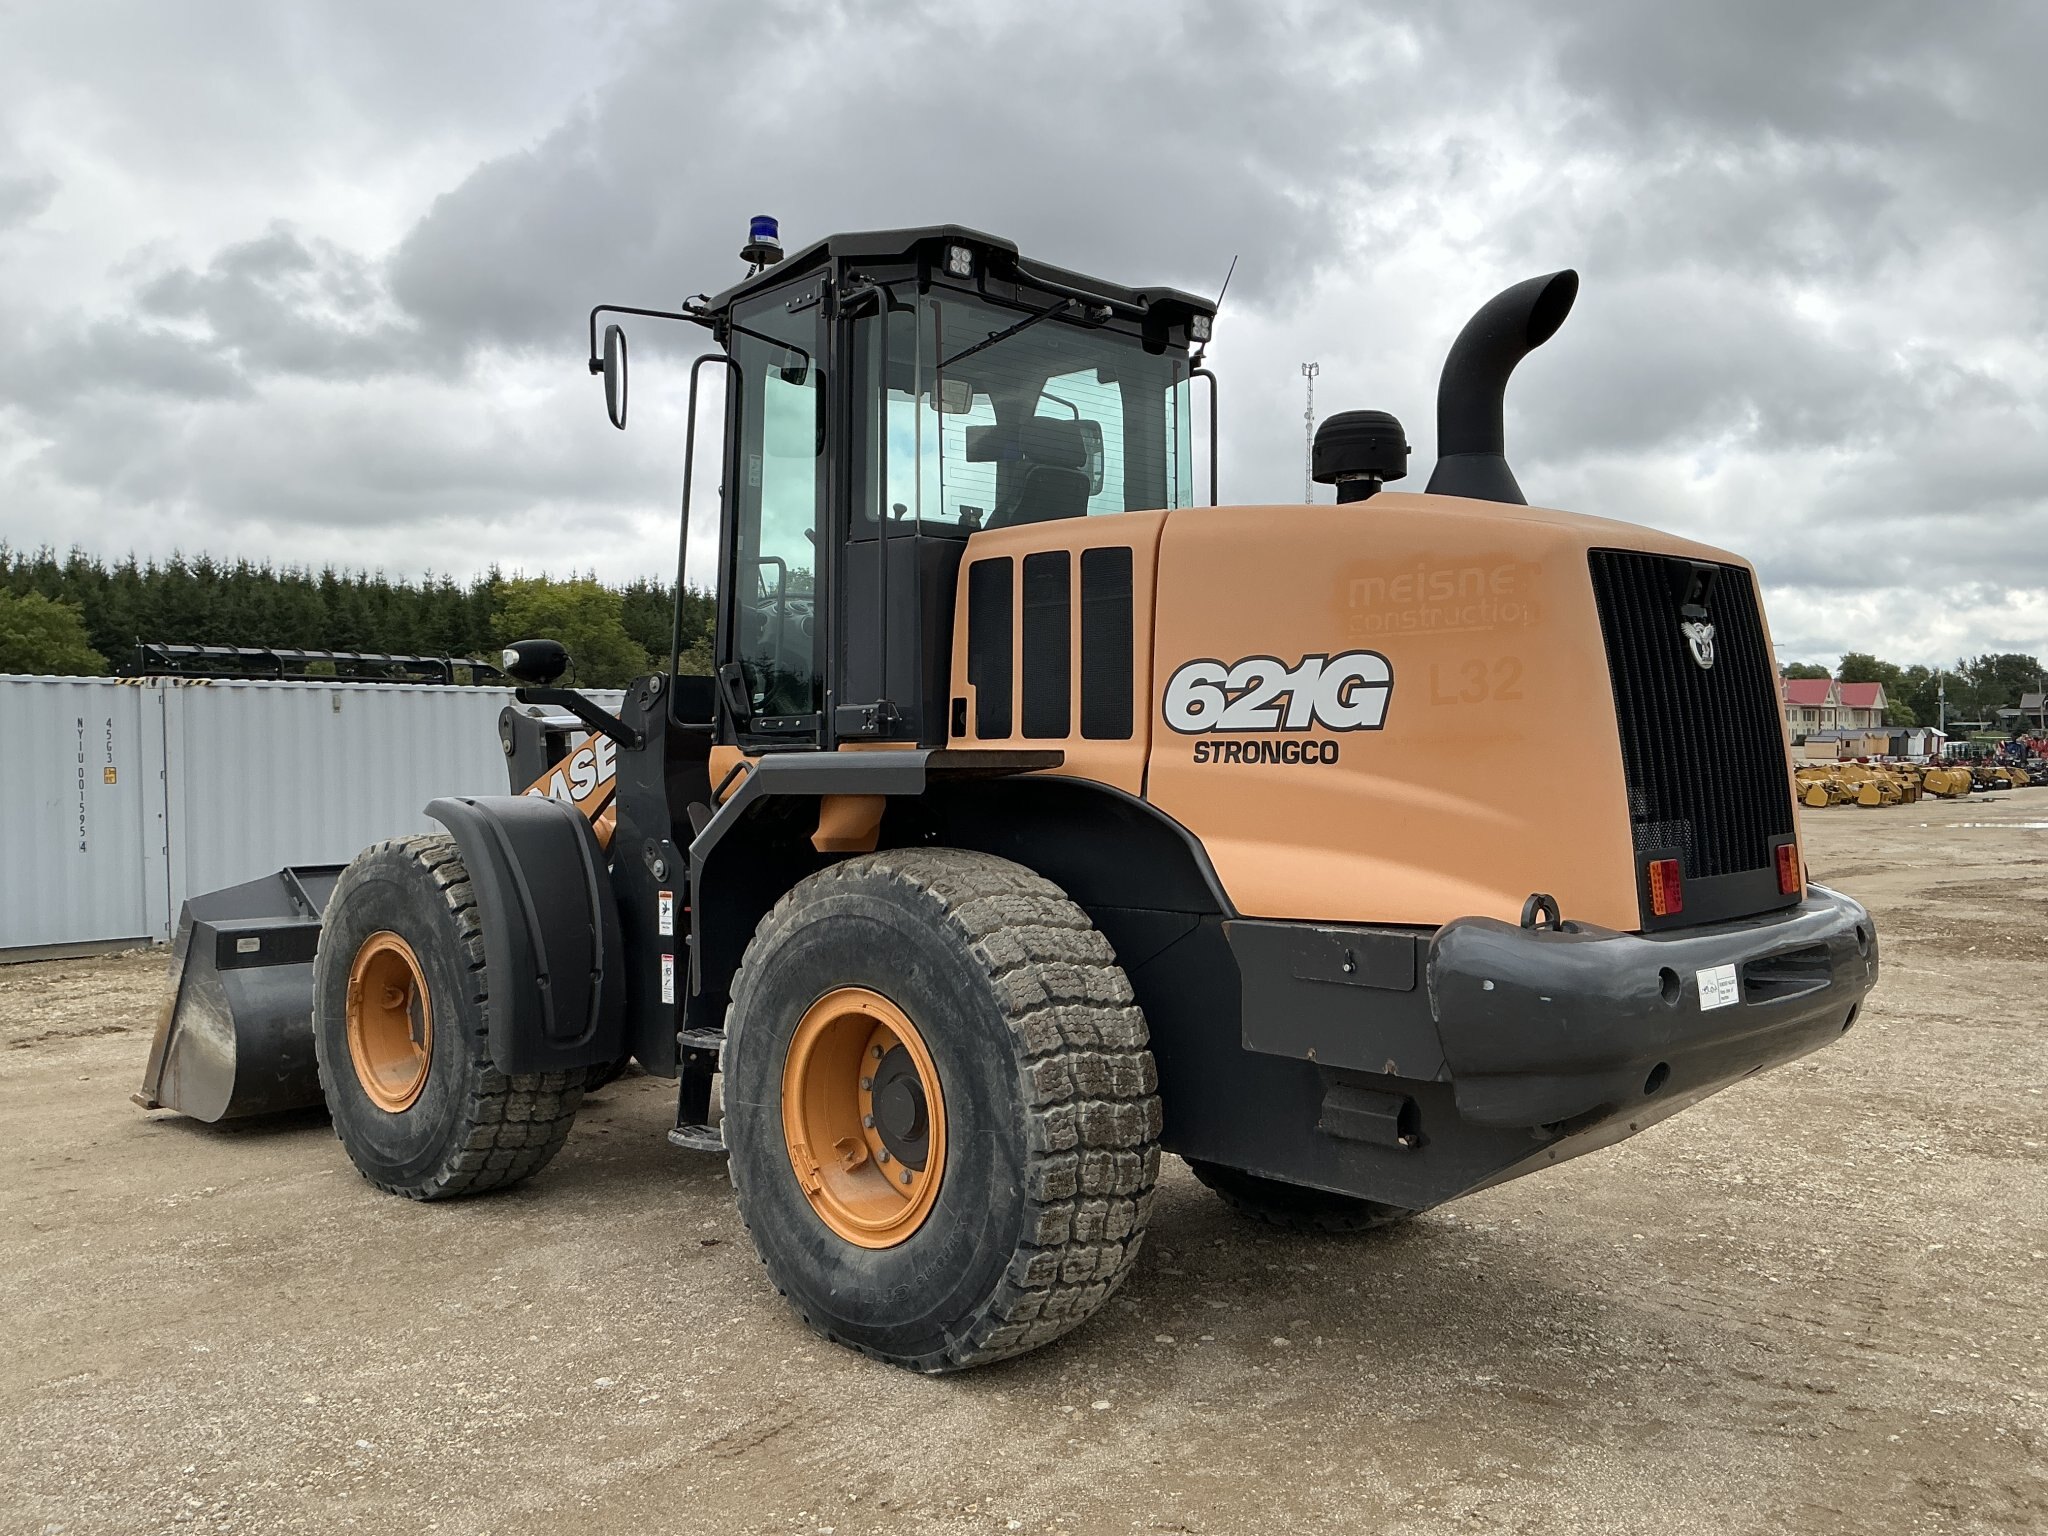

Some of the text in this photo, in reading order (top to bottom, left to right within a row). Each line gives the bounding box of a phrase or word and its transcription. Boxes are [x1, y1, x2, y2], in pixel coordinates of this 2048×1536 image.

[1162, 649, 1394, 735] 621G
[1428, 656, 1524, 706] L32
[105, 717, 113, 763] 45G3
[526, 732, 617, 804] ASE
[1193, 740, 1339, 764] STRONGCO
[78, 767, 86, 837] 001595
